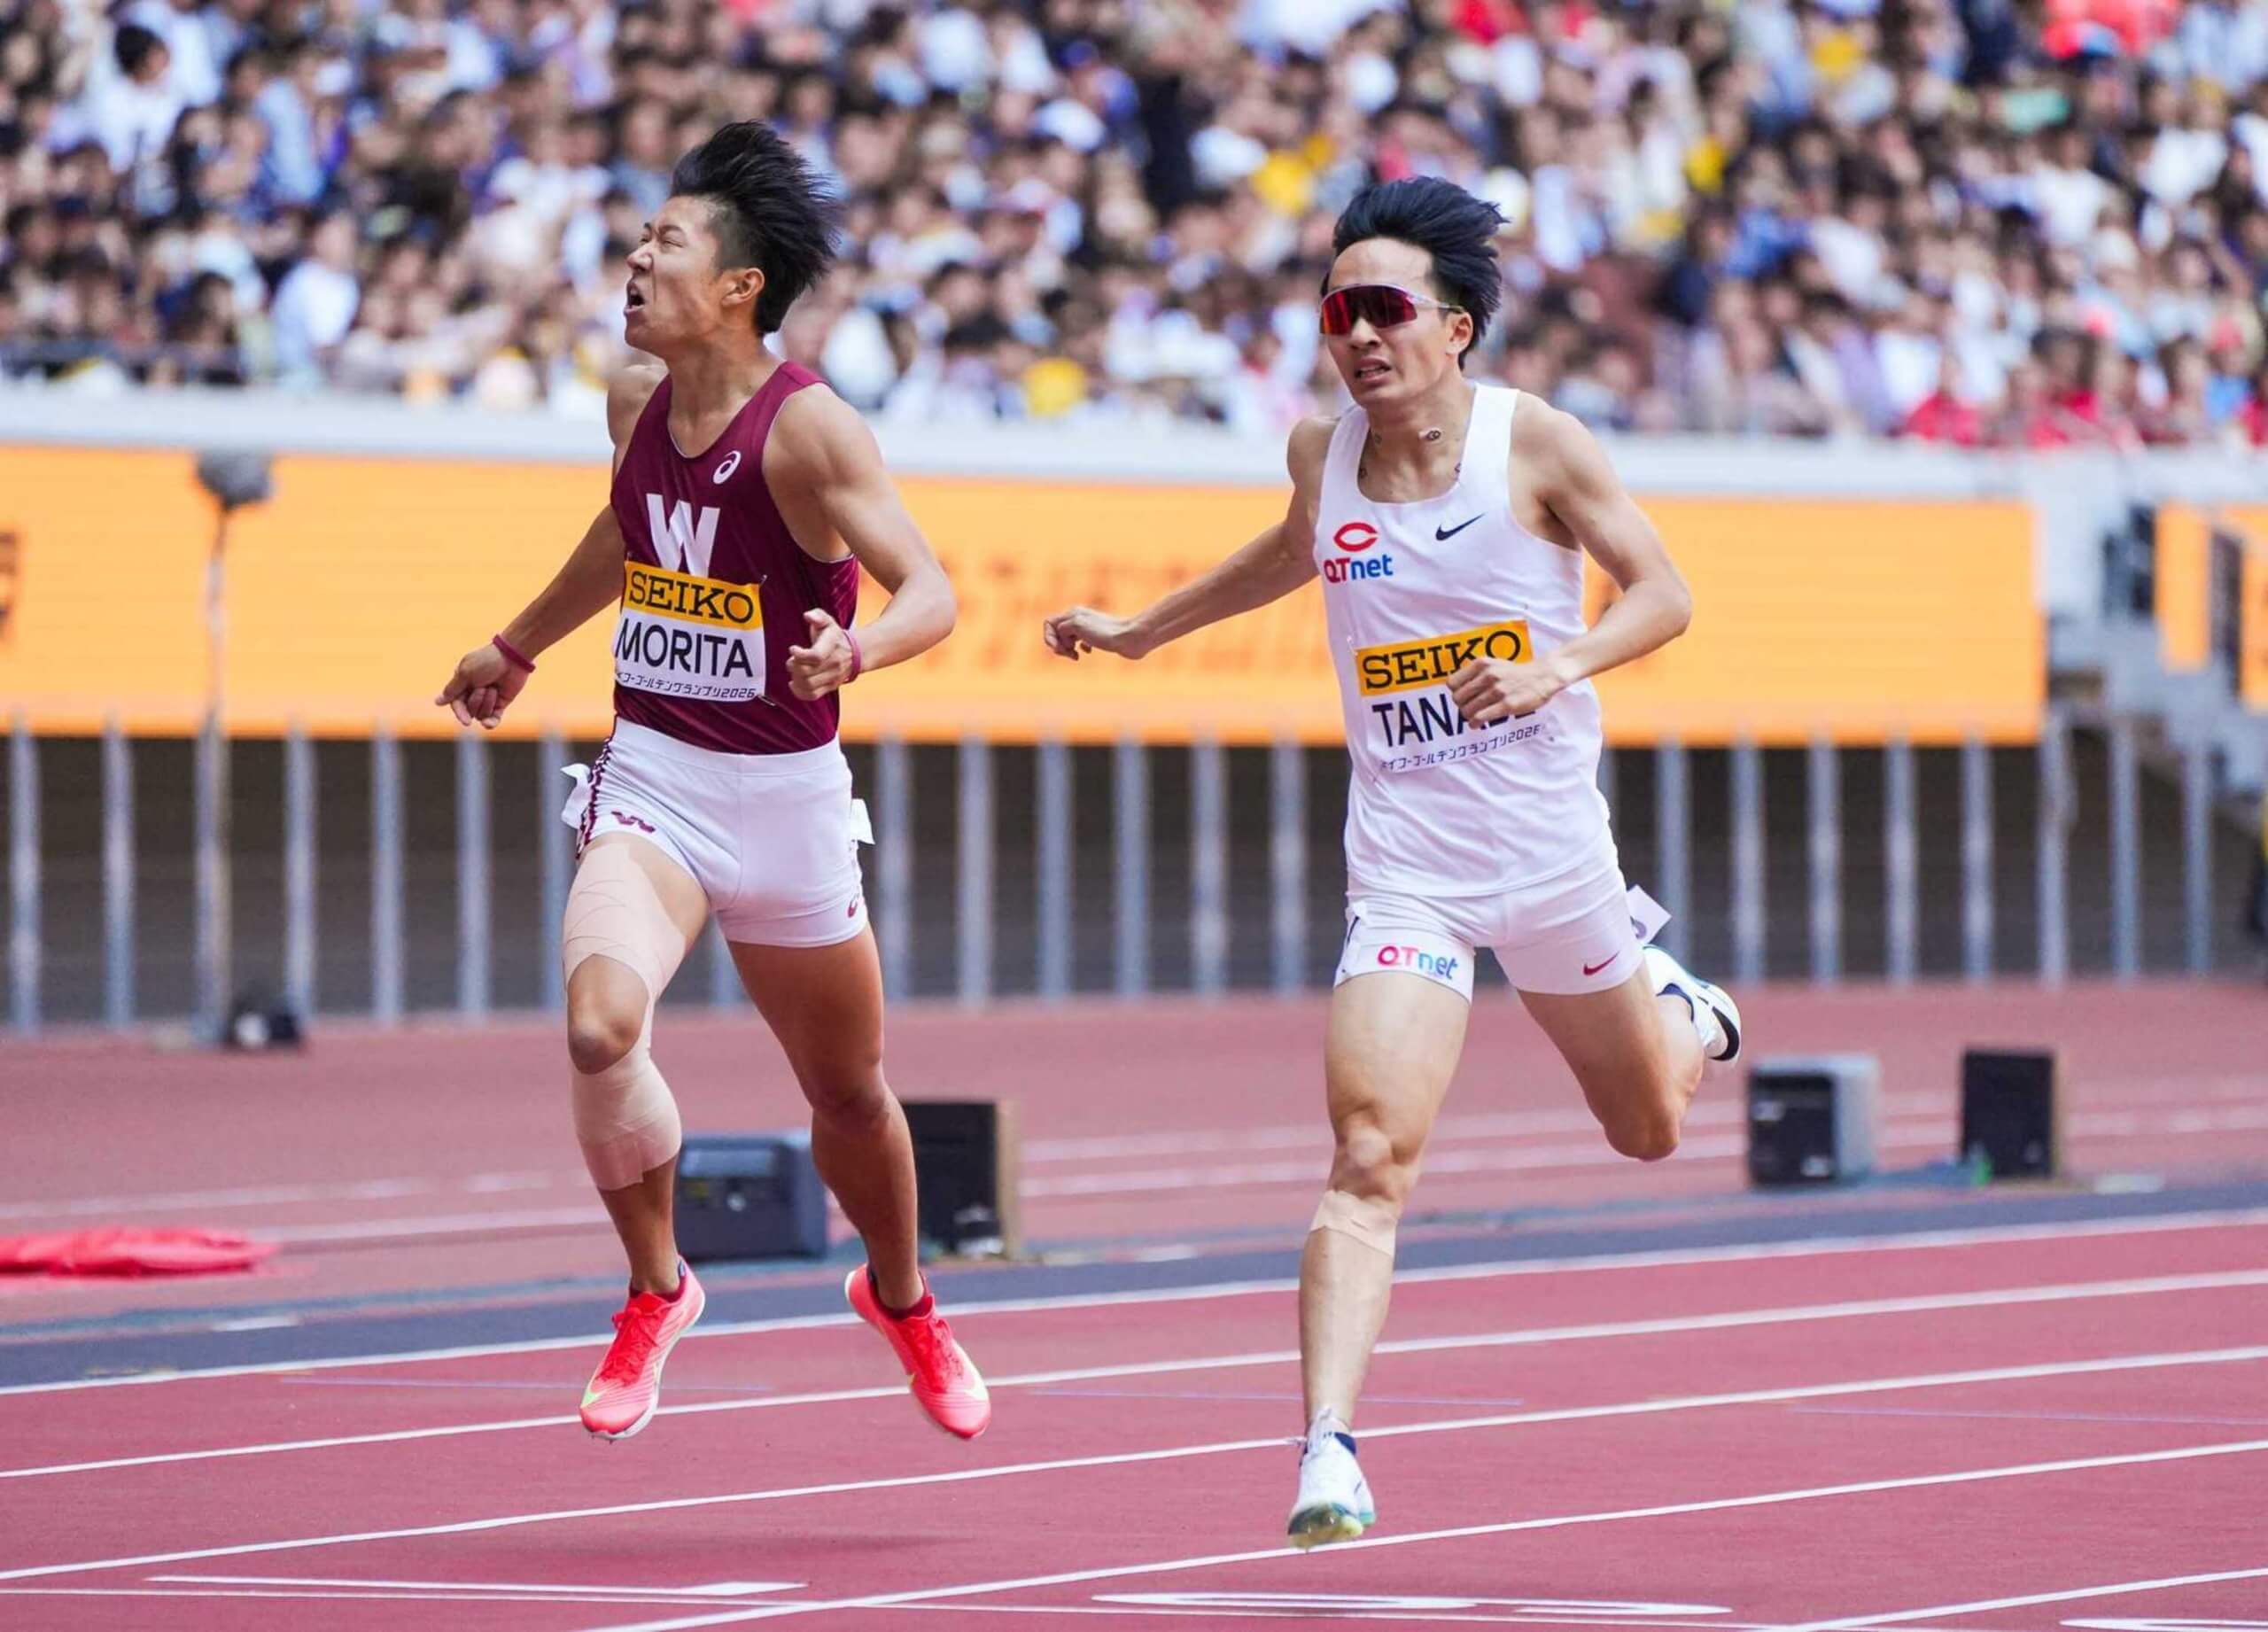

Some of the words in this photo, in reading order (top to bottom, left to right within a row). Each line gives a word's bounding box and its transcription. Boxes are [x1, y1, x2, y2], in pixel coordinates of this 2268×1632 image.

[646, 493, 721, 579] W
[1323, 554, 1394, 584] QTnet
[628, 570, 755, 624] SEIKO
[615, 618, 754, 678] MORITA
[1363, 630, 1522, 689] SEIKO
[1372, 693, 1536, 748] TAN
[1377, 945, 1458, 980] QTnet
